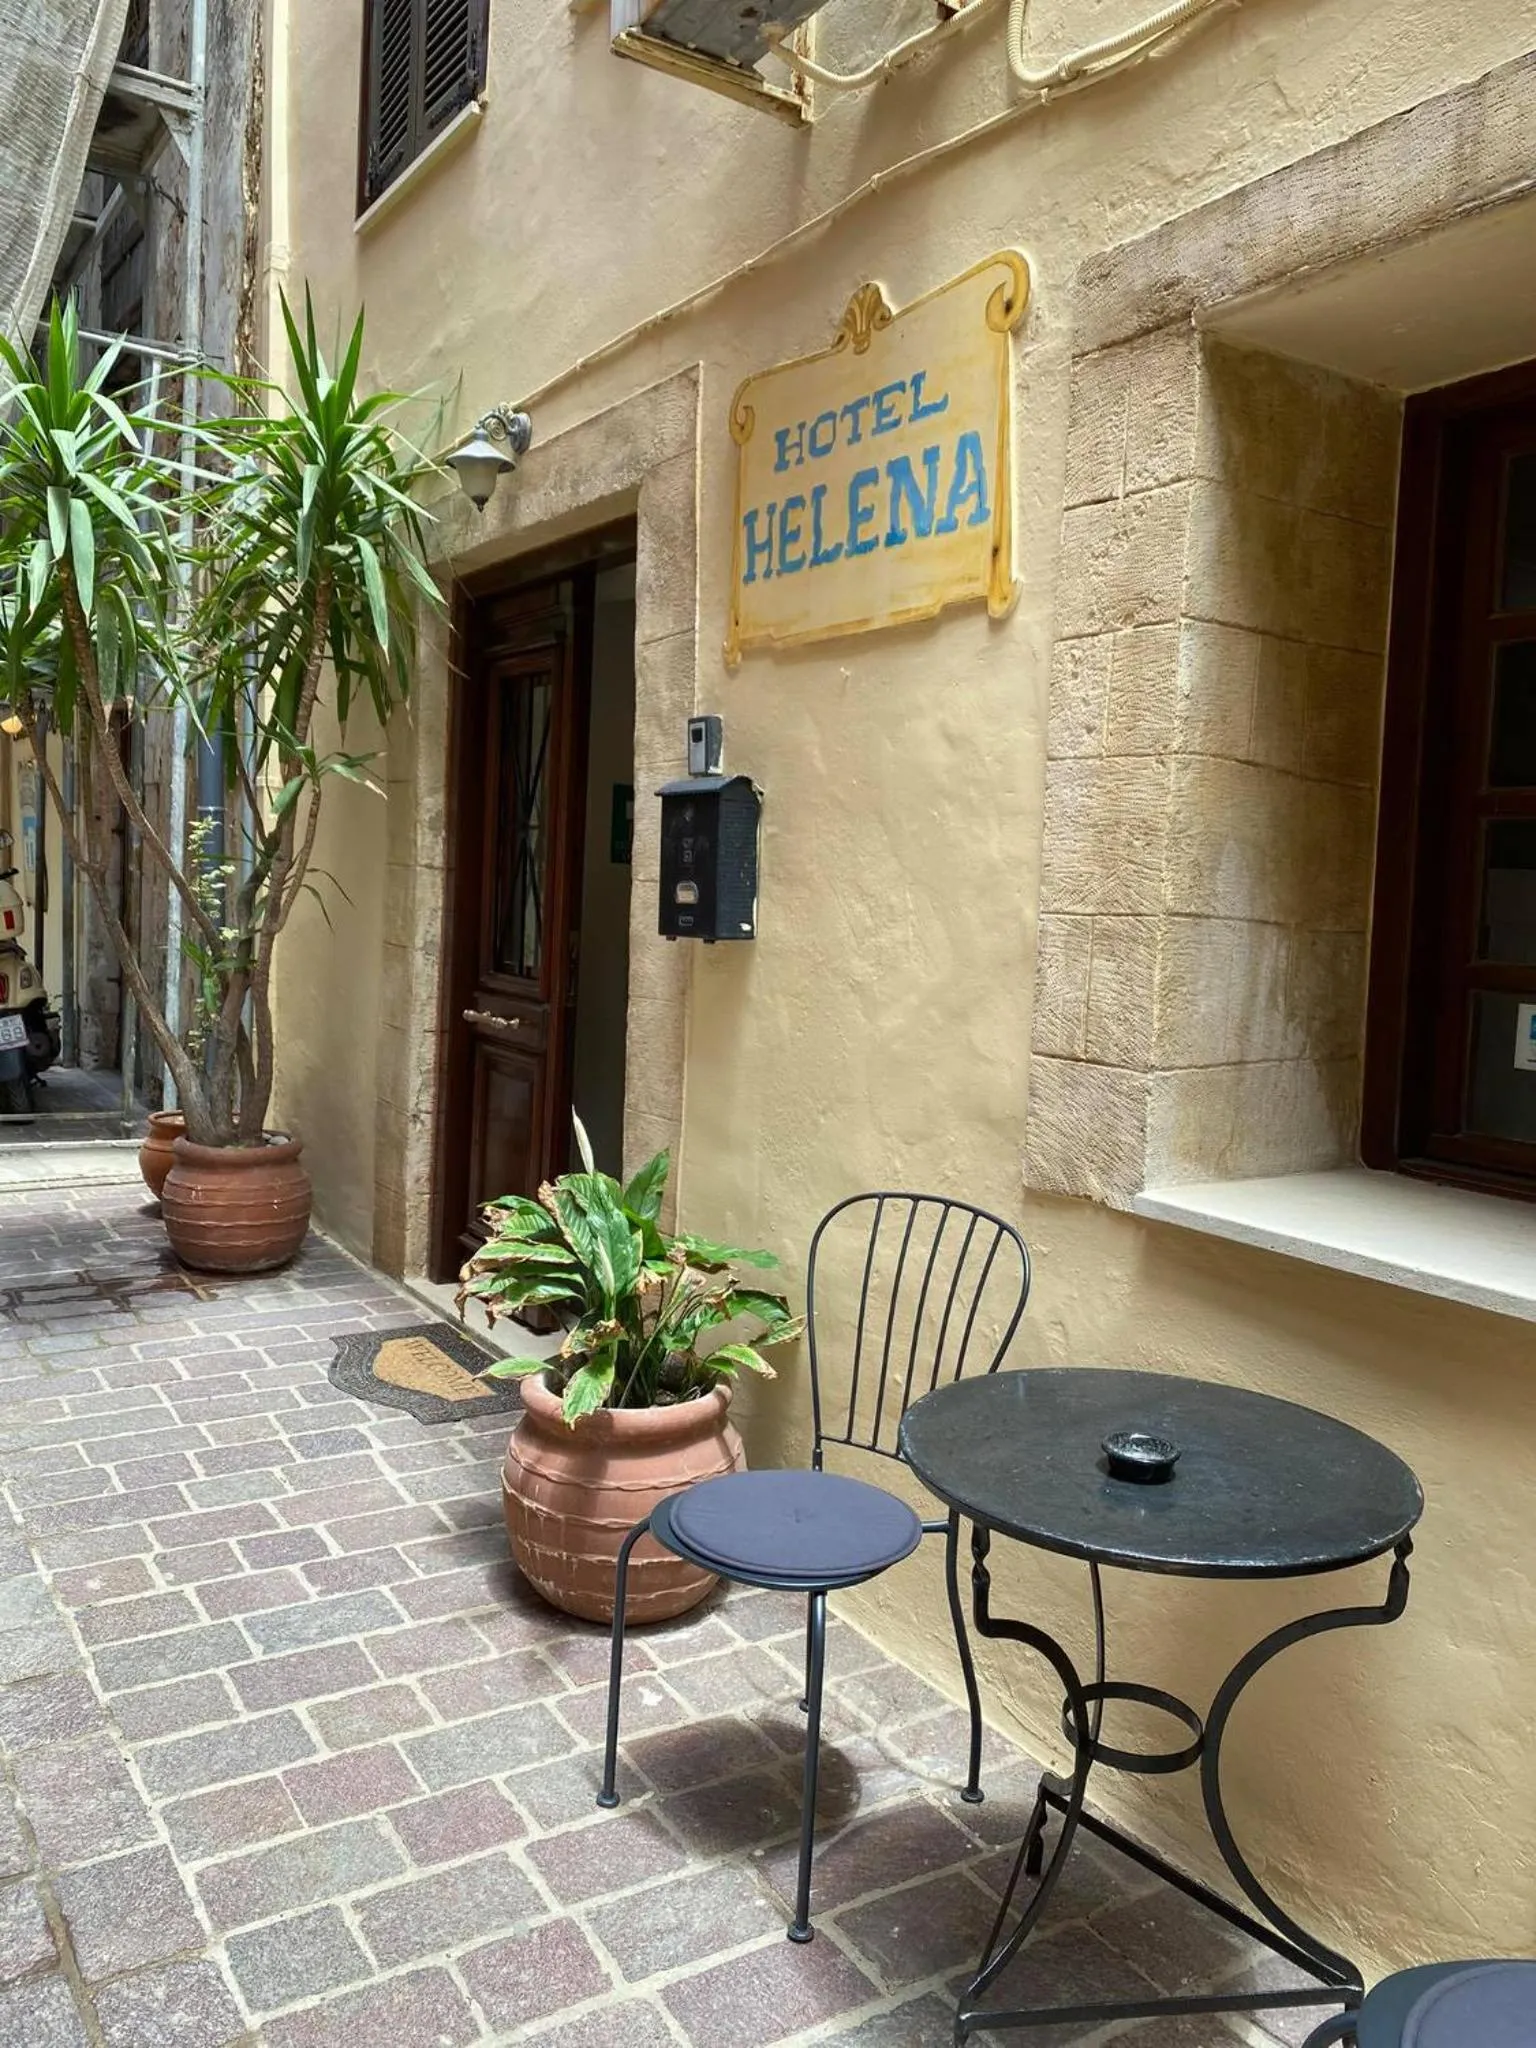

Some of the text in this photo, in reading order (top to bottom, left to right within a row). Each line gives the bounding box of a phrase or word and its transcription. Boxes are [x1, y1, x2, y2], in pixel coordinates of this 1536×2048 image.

[774, 371, 948, 472] HOTEL
[743, 431, 990, 584] HELENA
[403, 1339, 480, 1393] WELCOME
